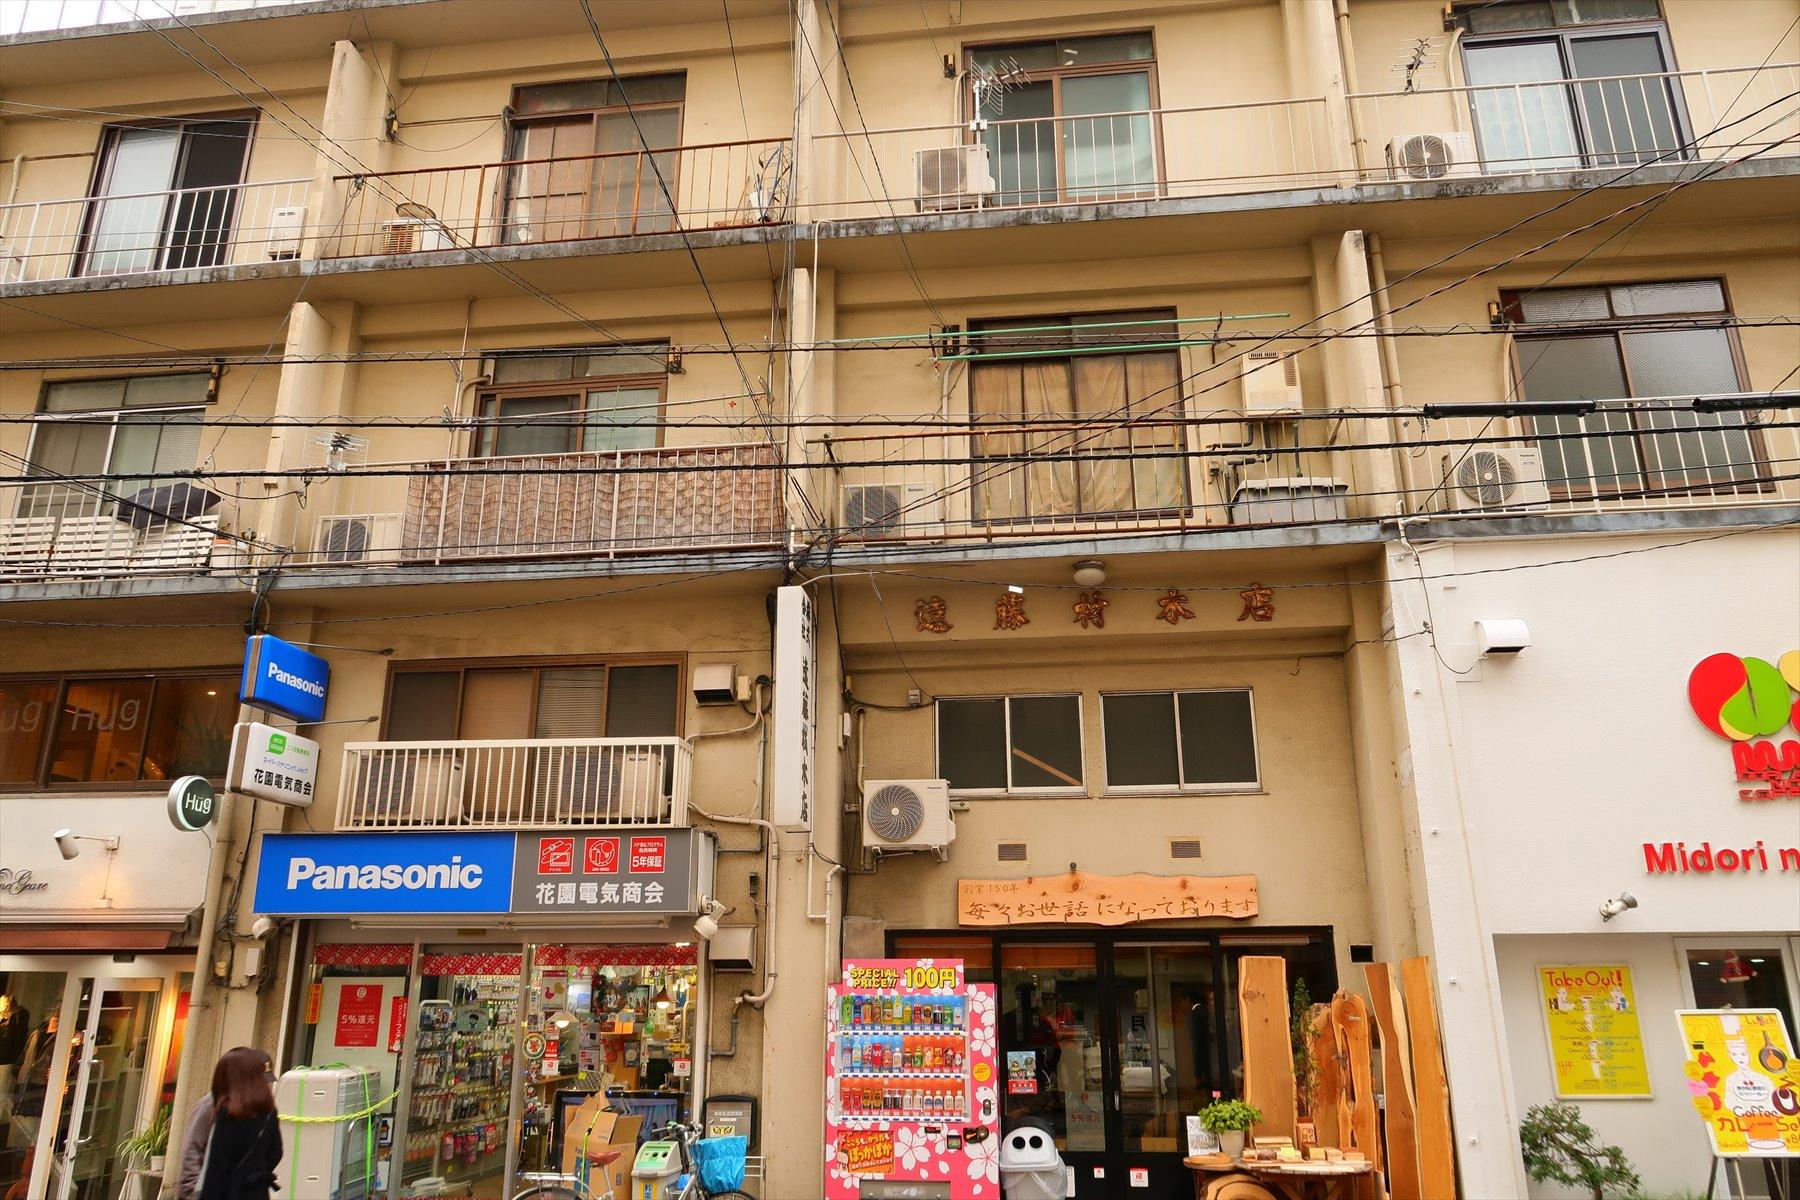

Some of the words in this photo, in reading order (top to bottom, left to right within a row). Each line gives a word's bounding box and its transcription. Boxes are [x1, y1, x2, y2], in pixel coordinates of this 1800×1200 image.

[267, 661, 325, 698] Panasonic
[71, 699, 141, 731] Hug
[254, 769, 312, 796] 花園電気商会
[185, 793, 212, 814] Hug
[632, 855, 663, 868] 5年保証
[1643, 841, 1768, 872] Midori
[286, 856, 483, 890] Panasonic
[535, 882, 665, 905] 花園電気商会
[963, 883, 1019, 895] 創業150年
[964, 898, 1255, 920] 毎々お世話になっております
[851, 968, 900, 979] SPECIAL
[853, 979, 897, 989] PRICE!!
[904, 967, 956, 989] 100円
[1545, 971, 1583, 987] Take
[1585, 970, 1623, 987] Out!
[341, 1014, 375, 1024] 5%還元
[1745, 1015, 1776, 1025] Luch
[1733, 1105, 1778, 1118] Coffee
